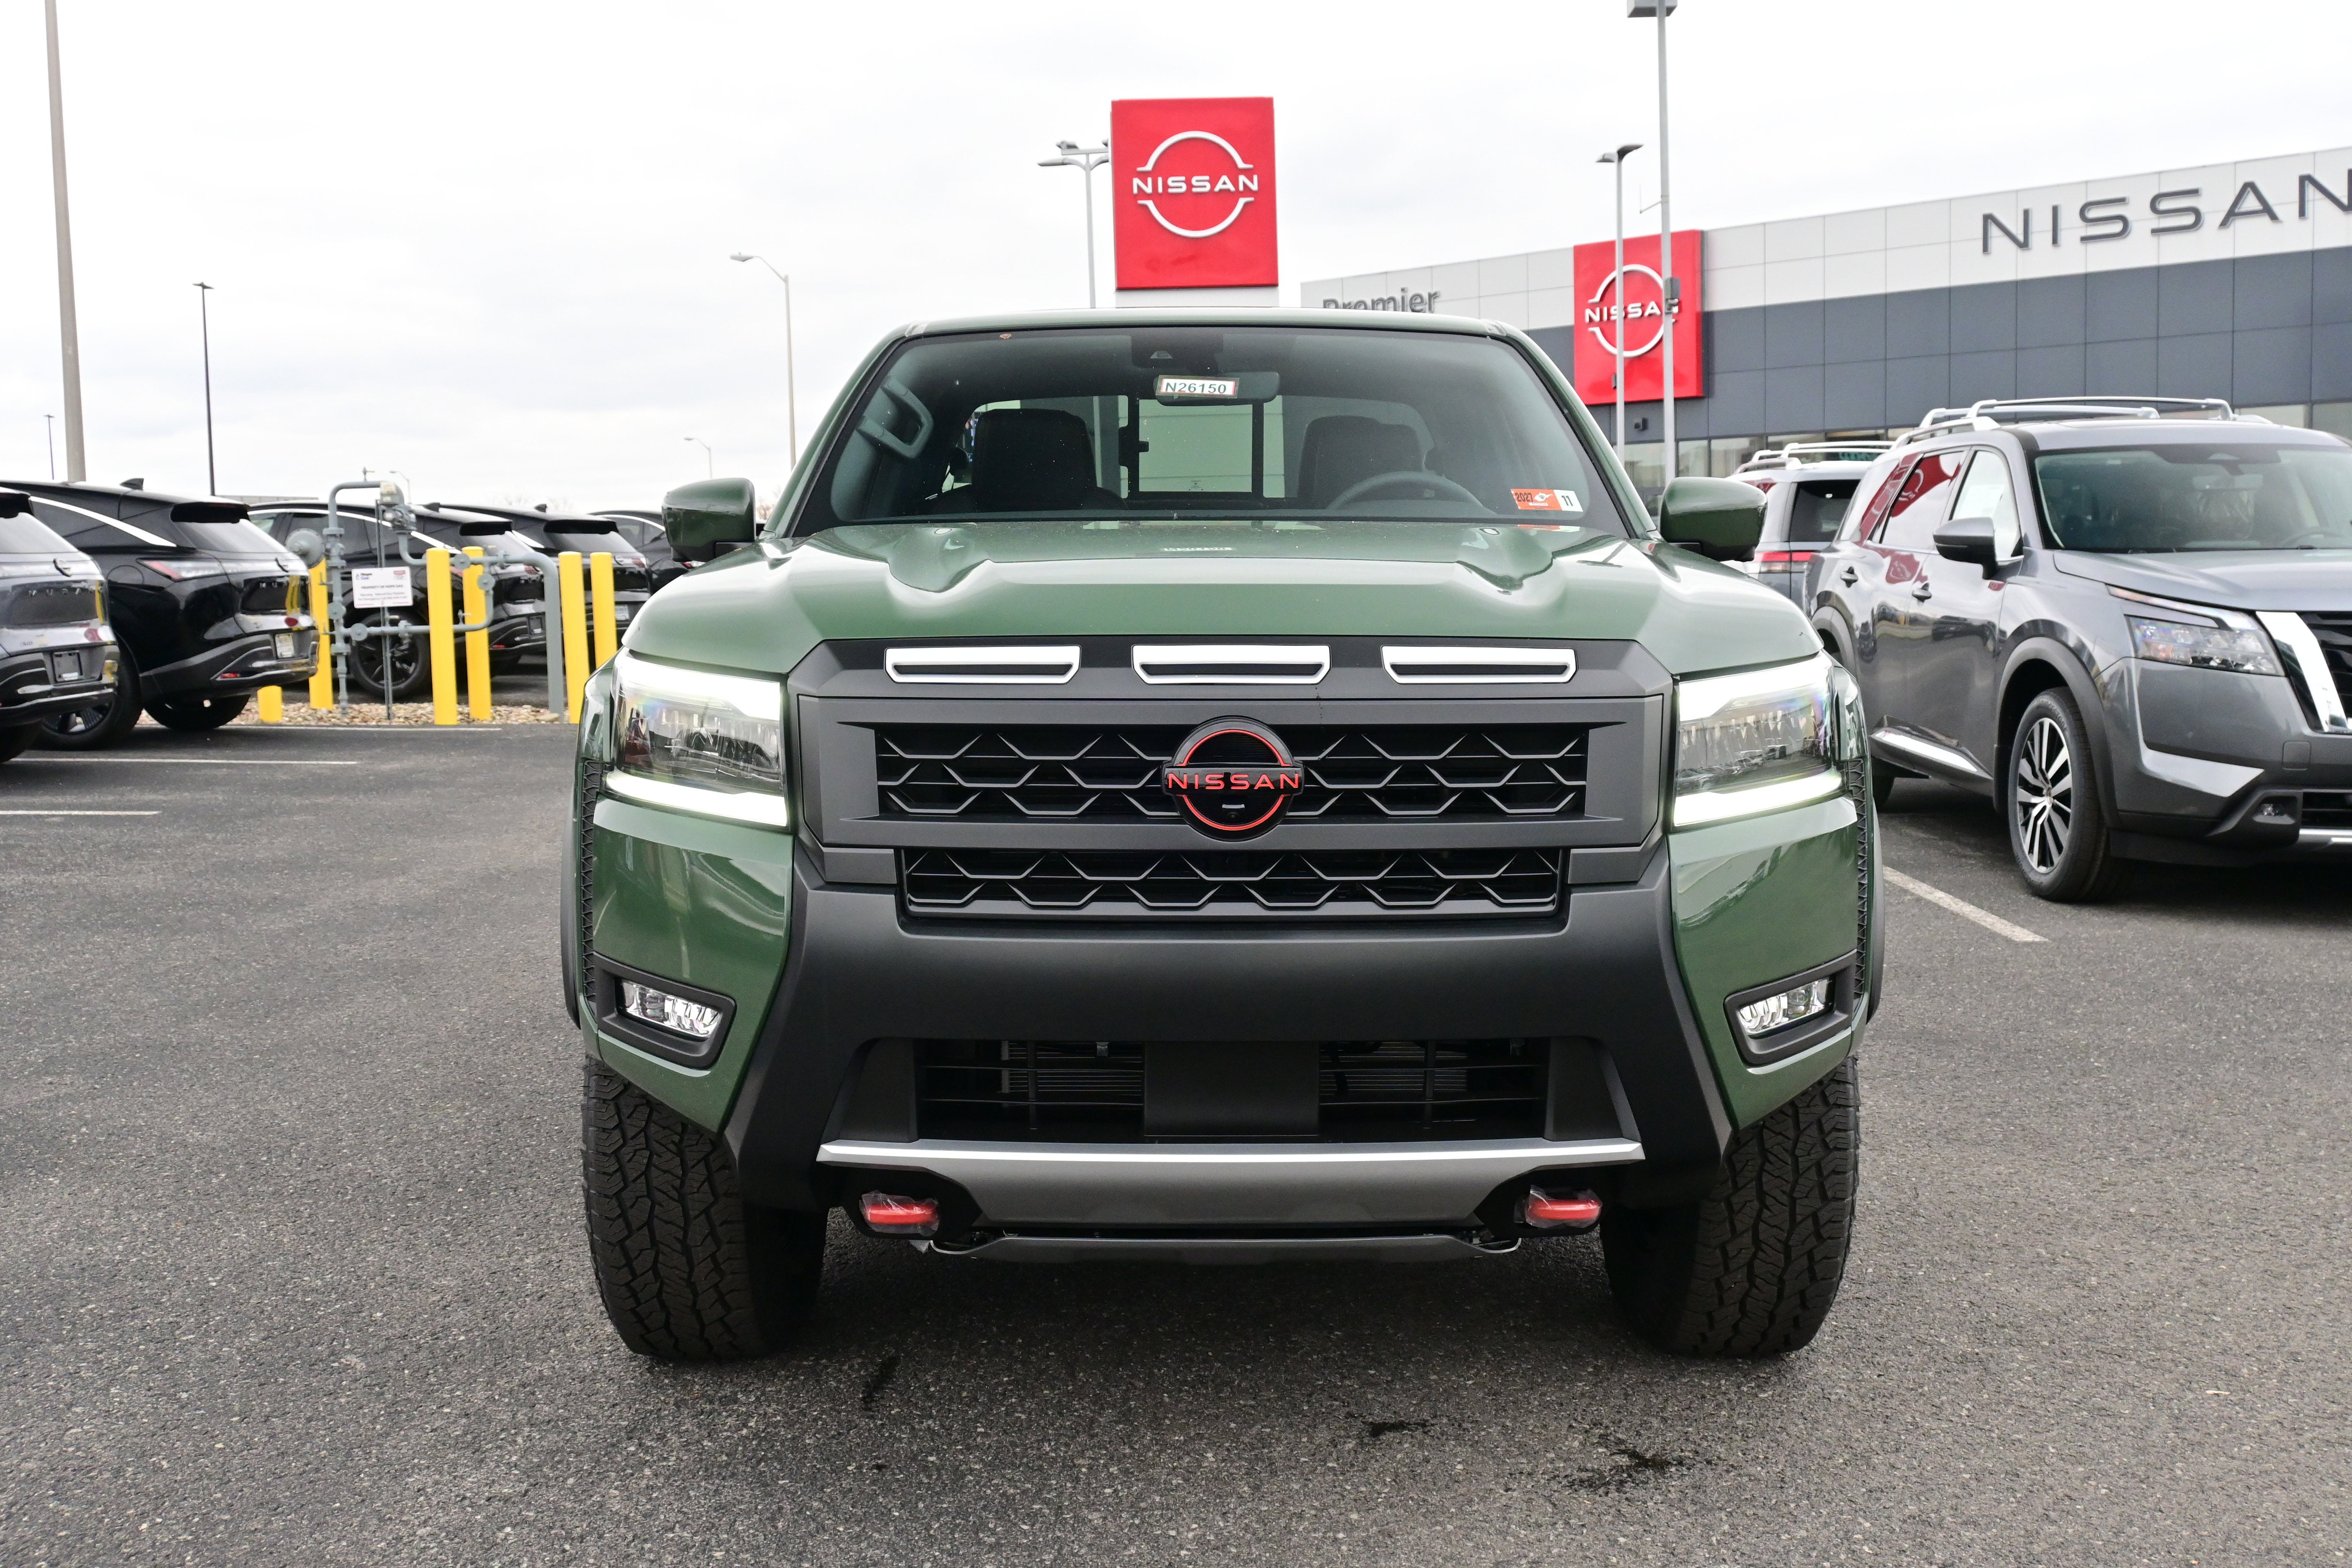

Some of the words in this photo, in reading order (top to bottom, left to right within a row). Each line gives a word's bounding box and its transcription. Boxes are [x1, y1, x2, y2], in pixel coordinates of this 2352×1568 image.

[1132, 174, 1259, 195] NISSAN
[1982, 168, 2352, 254] NISSAN
[1584, 298, 1679, 323] NISSA
[1165, 382, 1227, 394] N26150
[1515, 492, 1533, 502] 2027
[1561, 495, 1573, 506] 11
[1168, 773, 1299, 790] NISSAN
